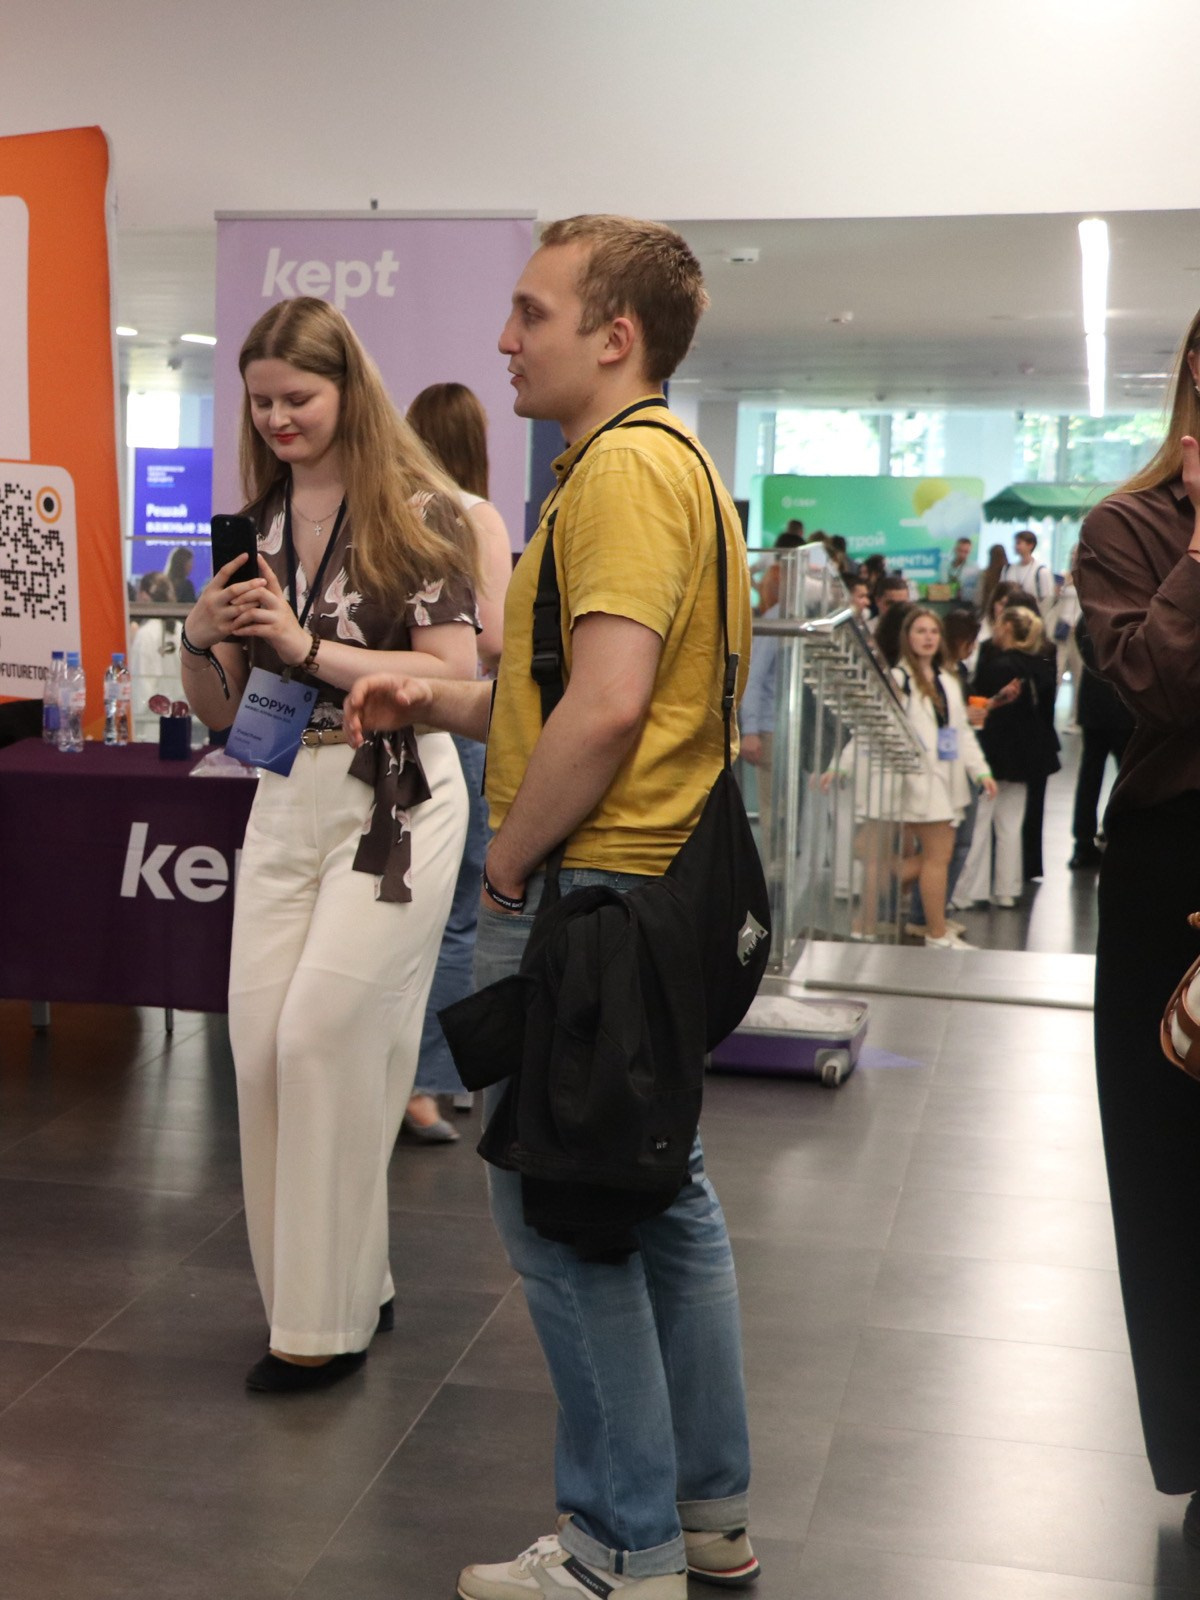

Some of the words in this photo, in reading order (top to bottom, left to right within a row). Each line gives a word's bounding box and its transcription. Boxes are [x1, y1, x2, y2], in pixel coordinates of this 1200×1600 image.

[261, 248, 400, 311] kept
[248, 693, 296, 718] ФОРУМ
[120, 821, 243, 903] ke
